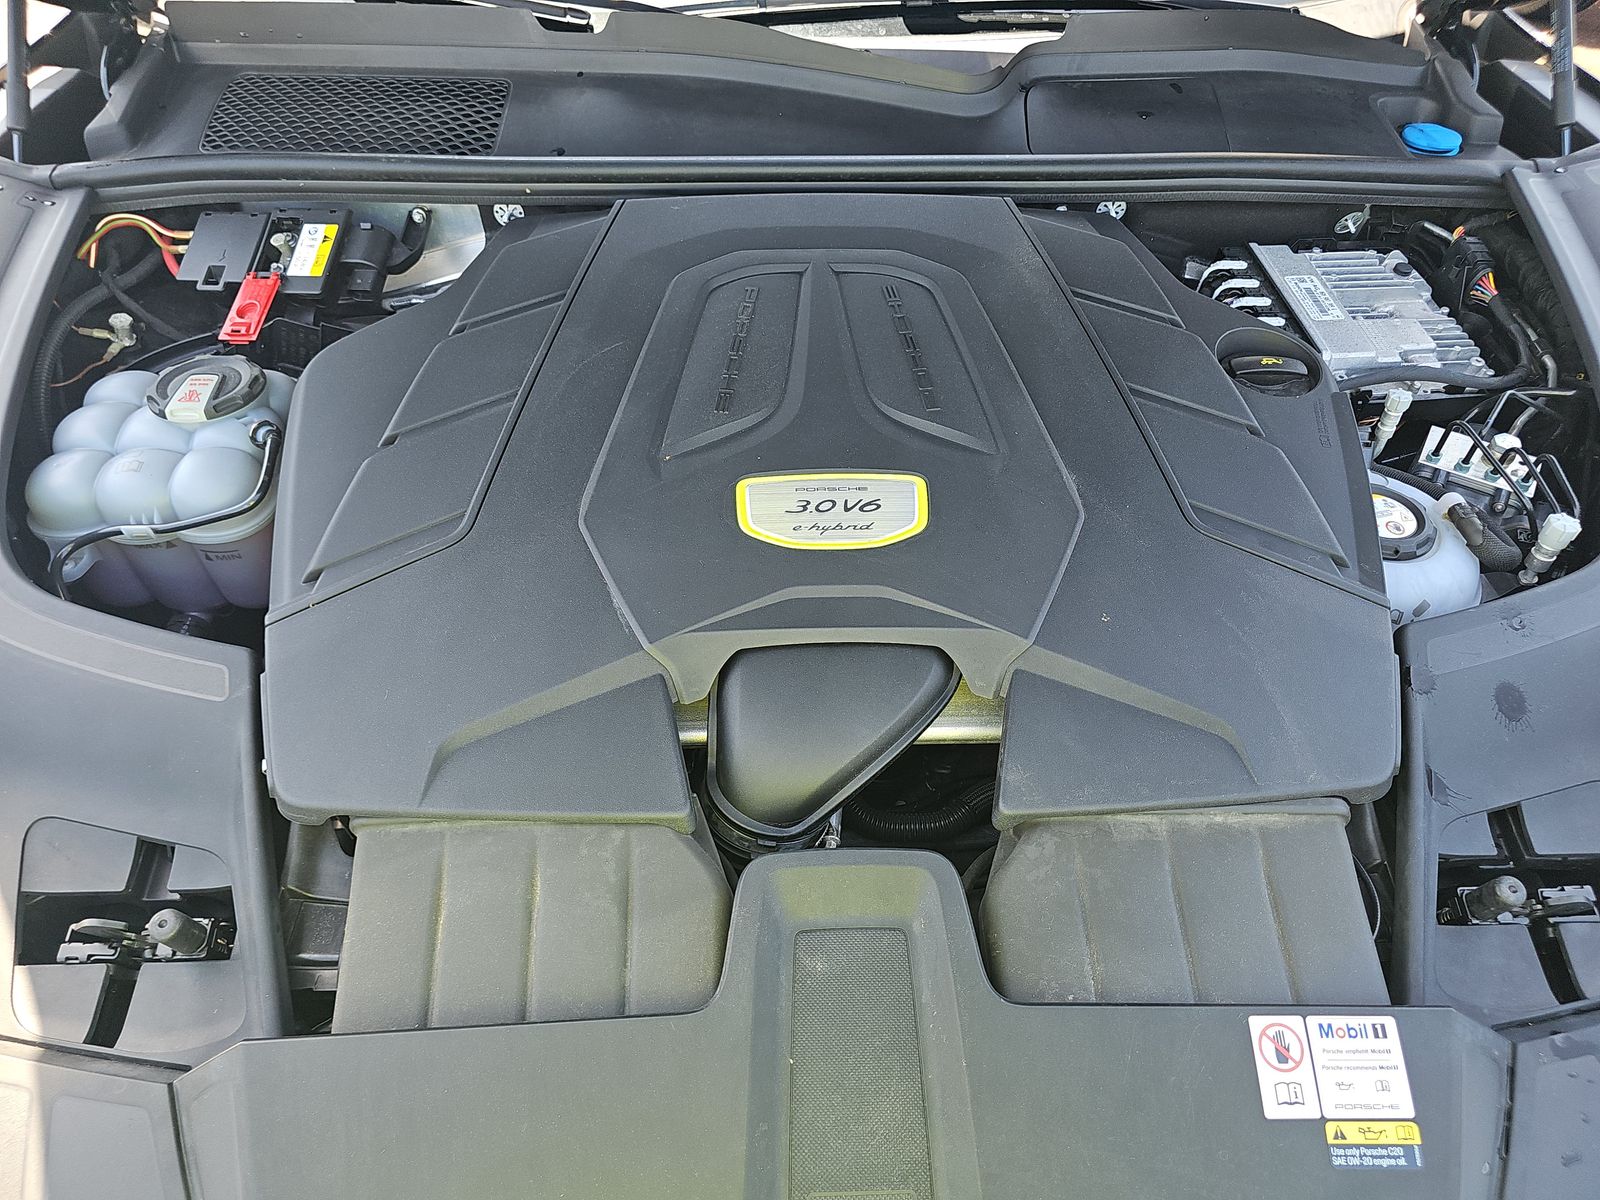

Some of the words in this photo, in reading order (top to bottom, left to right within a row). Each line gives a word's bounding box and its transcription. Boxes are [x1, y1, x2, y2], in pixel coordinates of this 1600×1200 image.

[713, 286, 761, 415] PORSCHE
[883, 284, 942, 413] PORSCHE
[785, 499, 837, 514] 3.0
[843, 498, 882, 513] V6
[792, 522, 875, 536] e-hybrid
[214, 552, 243, 561] MIN
[1318, 1023, 1369, 1039] Mobil
[1372, 1023, 1388, 1039] 1
[1330, 1147, 1345, 1156] Use
[1345, 1147, 1360, 1157] only
[1360, 1147, 1388, 1156] Porsche
[1388, 1147, 1404, 1156] C20
[1331, 1157, 1347, 1166] SAE
[1347, 1157, 1373, 1166] 0W-20
[1373, 1158, 1396, 1167] engine
